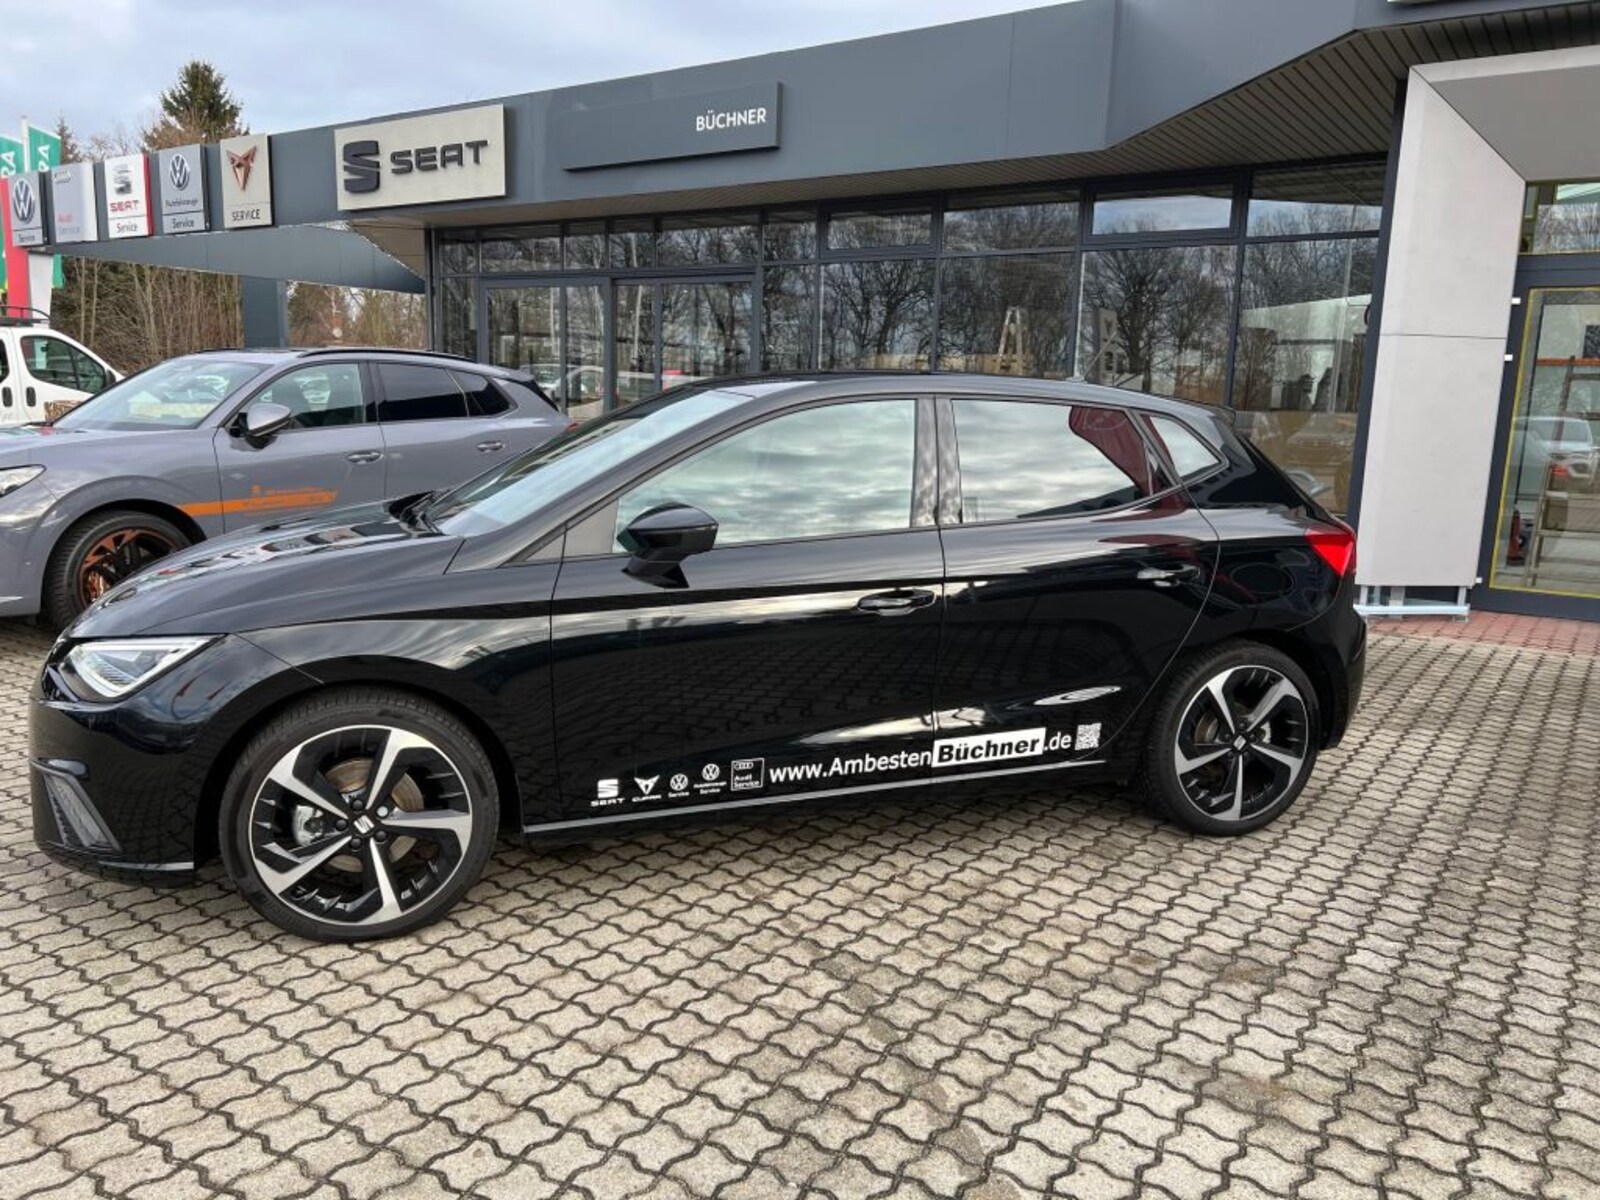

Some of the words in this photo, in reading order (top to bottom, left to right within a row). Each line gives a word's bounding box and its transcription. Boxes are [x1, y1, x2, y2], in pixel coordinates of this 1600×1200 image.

[696, 107, 767, 132] BÜCHNER
[390, 140, 488, 175] SEAT
[110, 200, 139, 212] SEAT
[232, 208, 261, 221] SERVICE
[116, 223, 138, 233] Service
